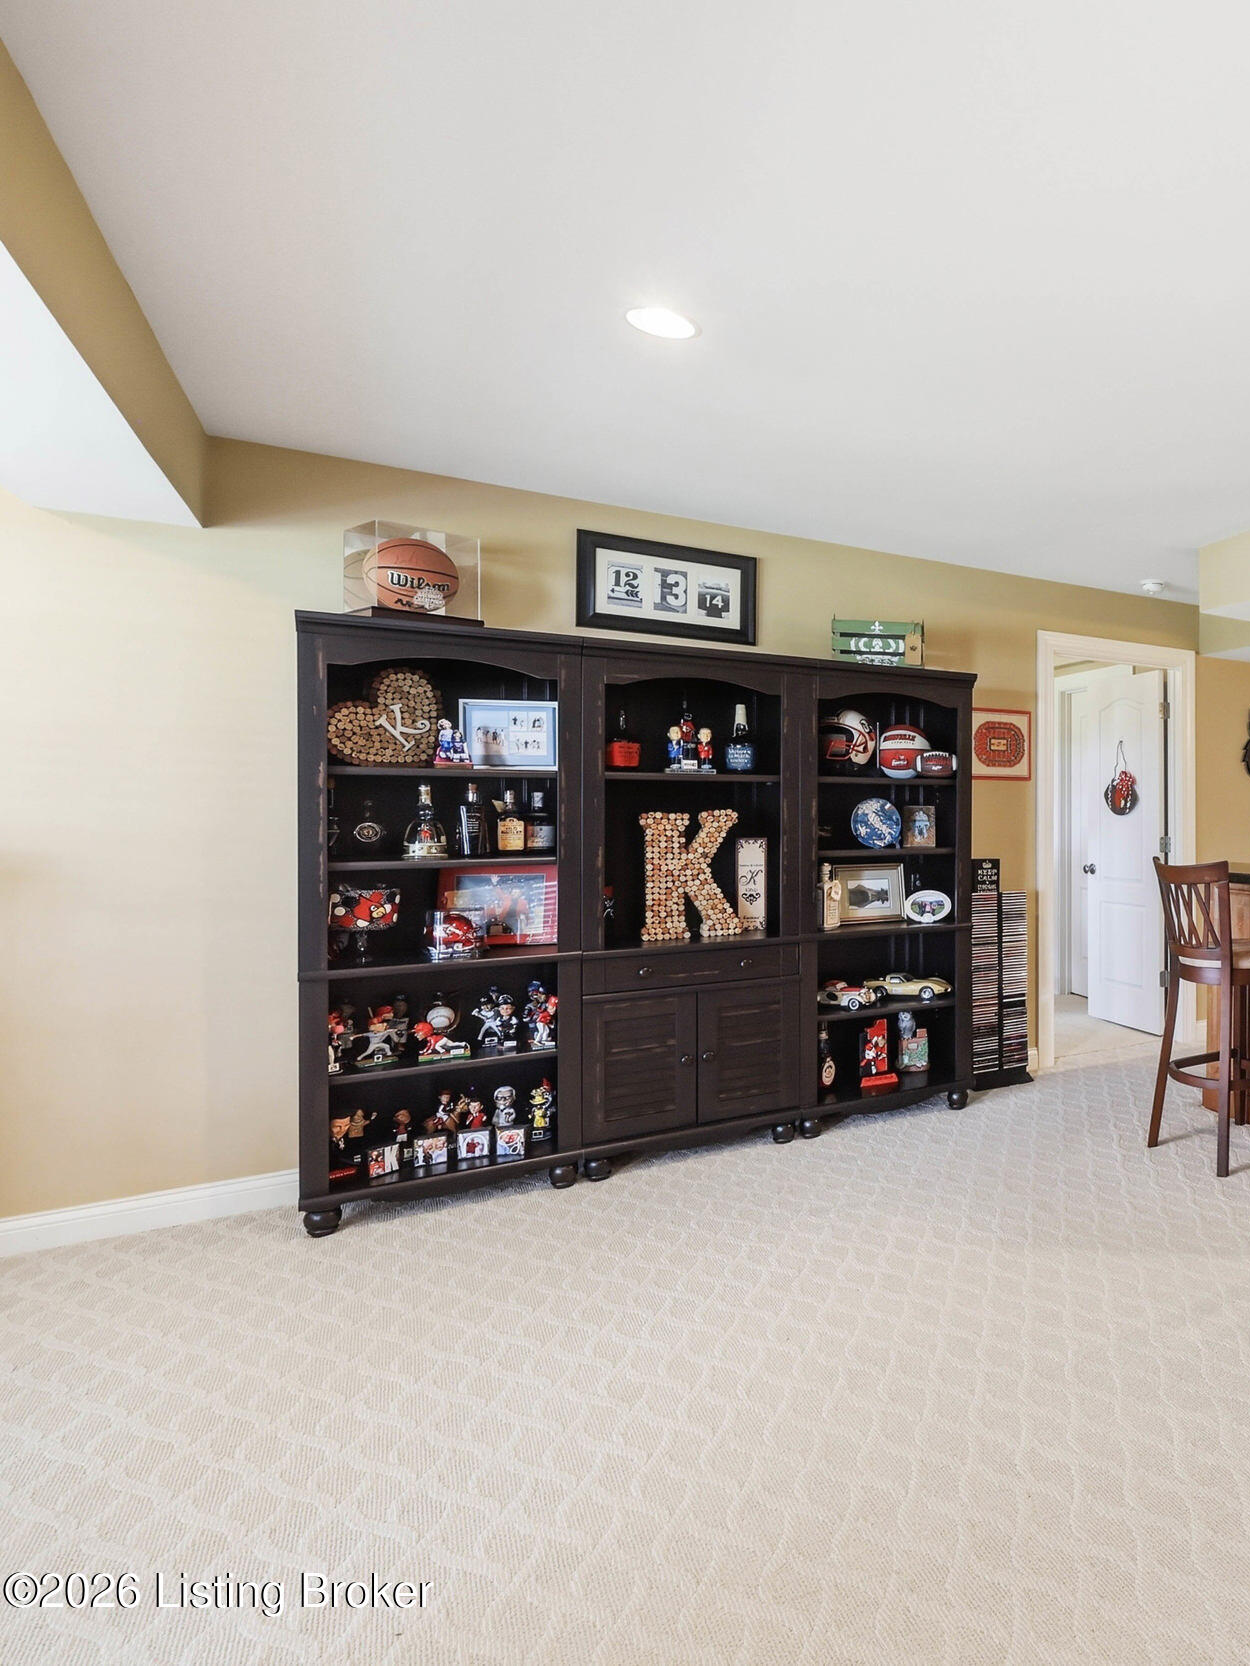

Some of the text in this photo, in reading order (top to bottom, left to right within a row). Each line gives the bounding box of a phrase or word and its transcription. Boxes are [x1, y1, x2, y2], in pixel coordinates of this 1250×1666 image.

[387, 570, 450, 592] Wilson
[612, 569, 640, 588] 12
[653, 571, 688, 608] 13
[704, 594, 724, 609] 14
[374, 703, 430, 752] K
[639, 809, 743, 942] K
